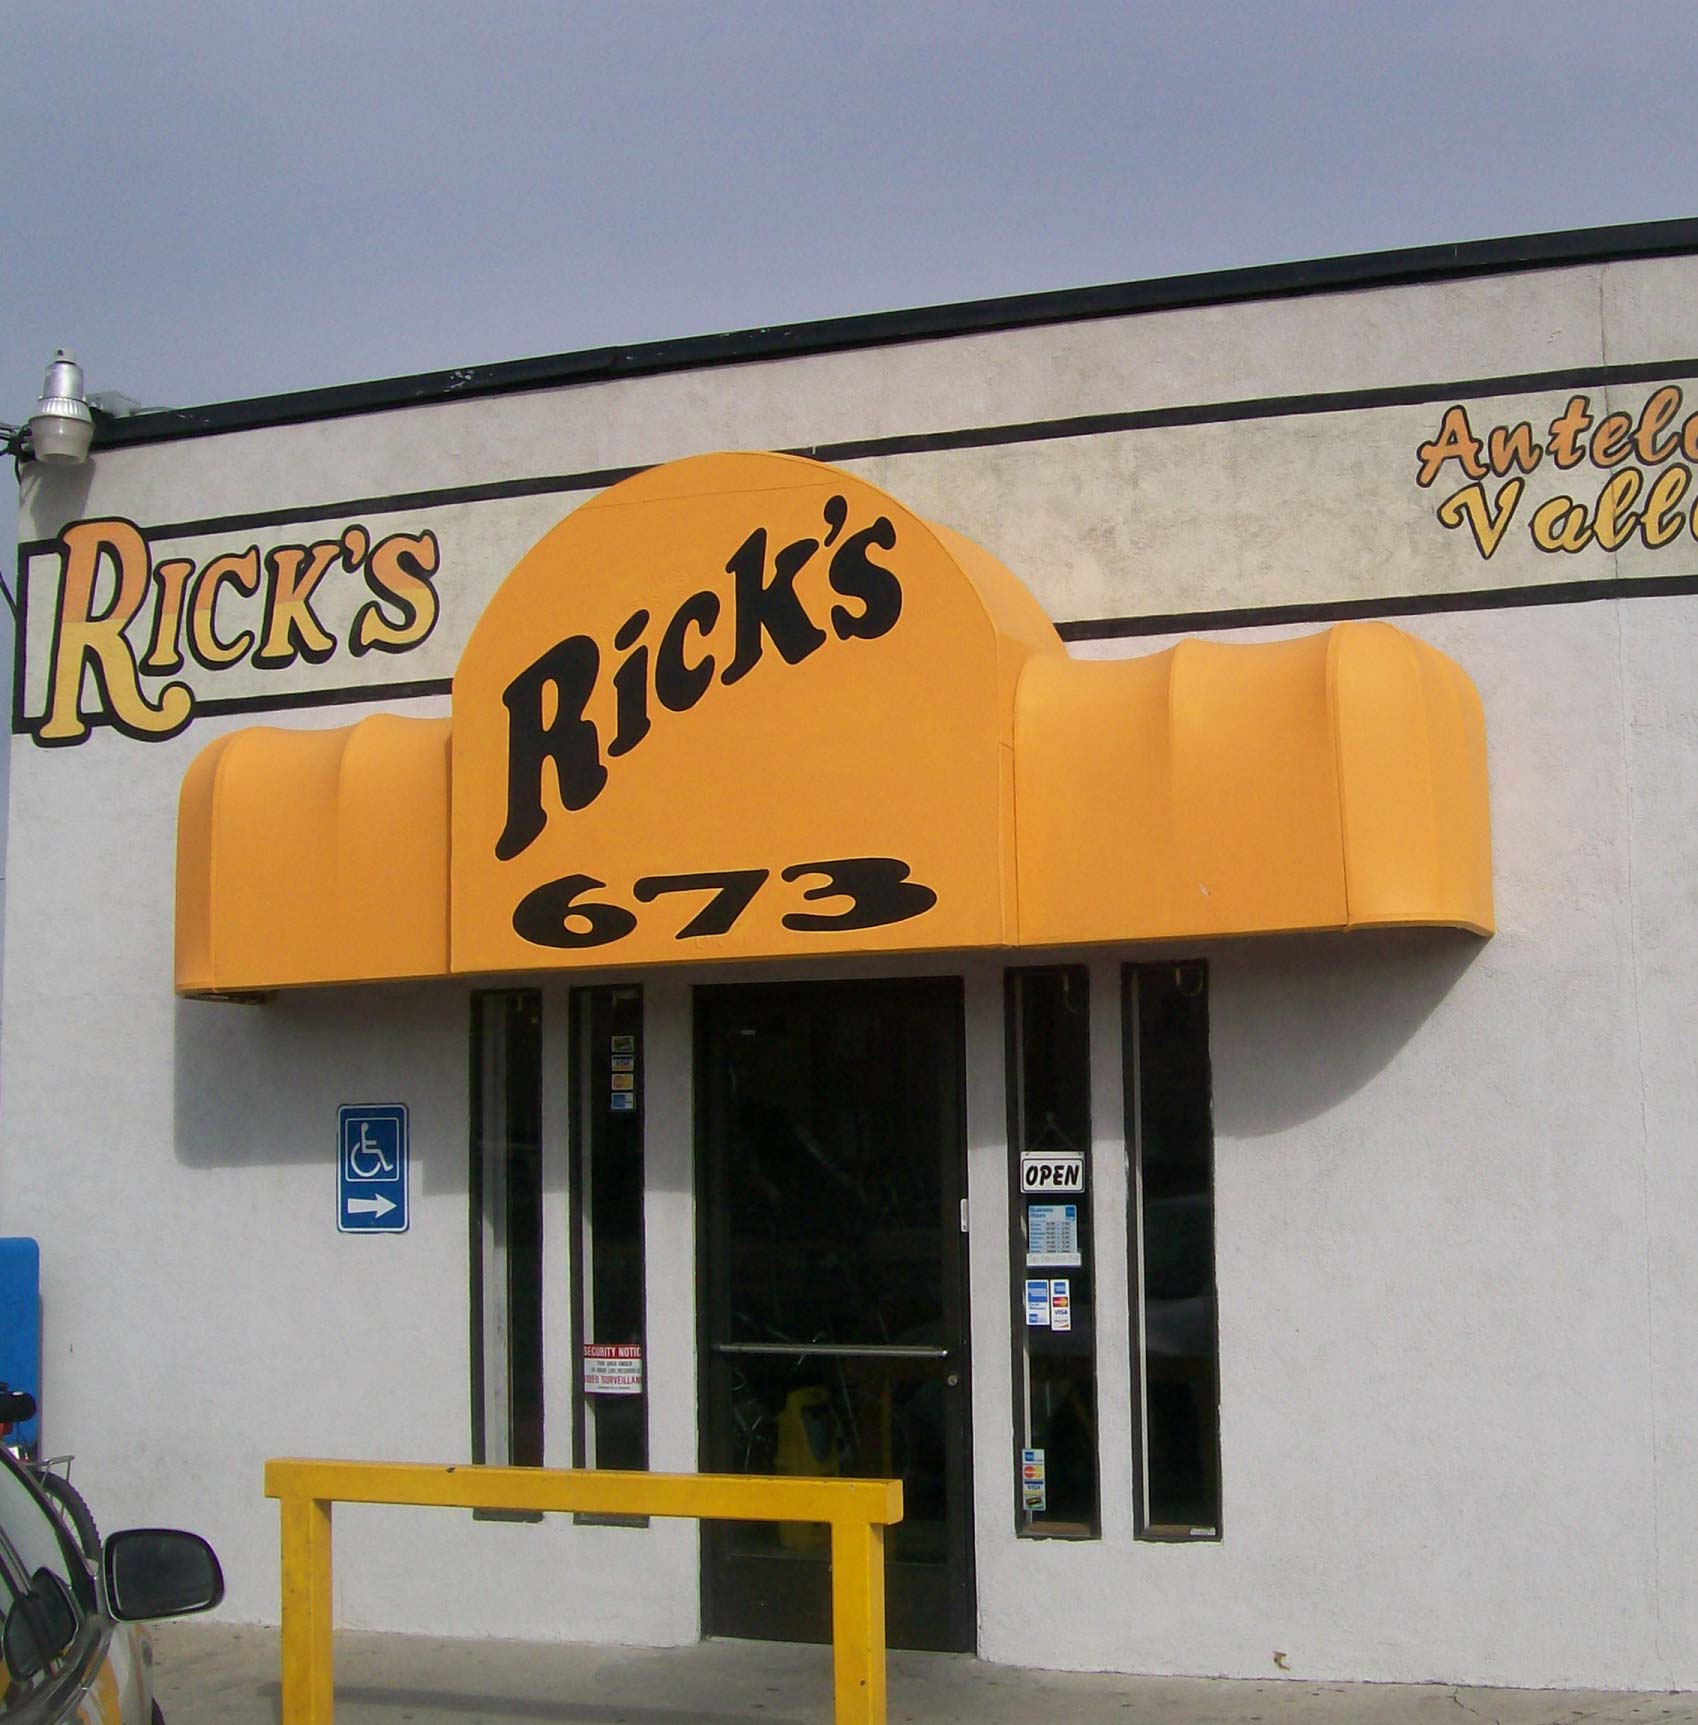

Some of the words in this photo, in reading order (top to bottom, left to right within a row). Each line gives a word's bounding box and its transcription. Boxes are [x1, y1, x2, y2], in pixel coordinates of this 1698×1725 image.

[1436, 463, 1698, 560] Vall
[33, 516, 440, 748] RICK'S
[512, 857, 938, 948] 673
[1025, 1164, 1080, 1186] OPEN
[584, 1345, 616, 1357] SECURITY
